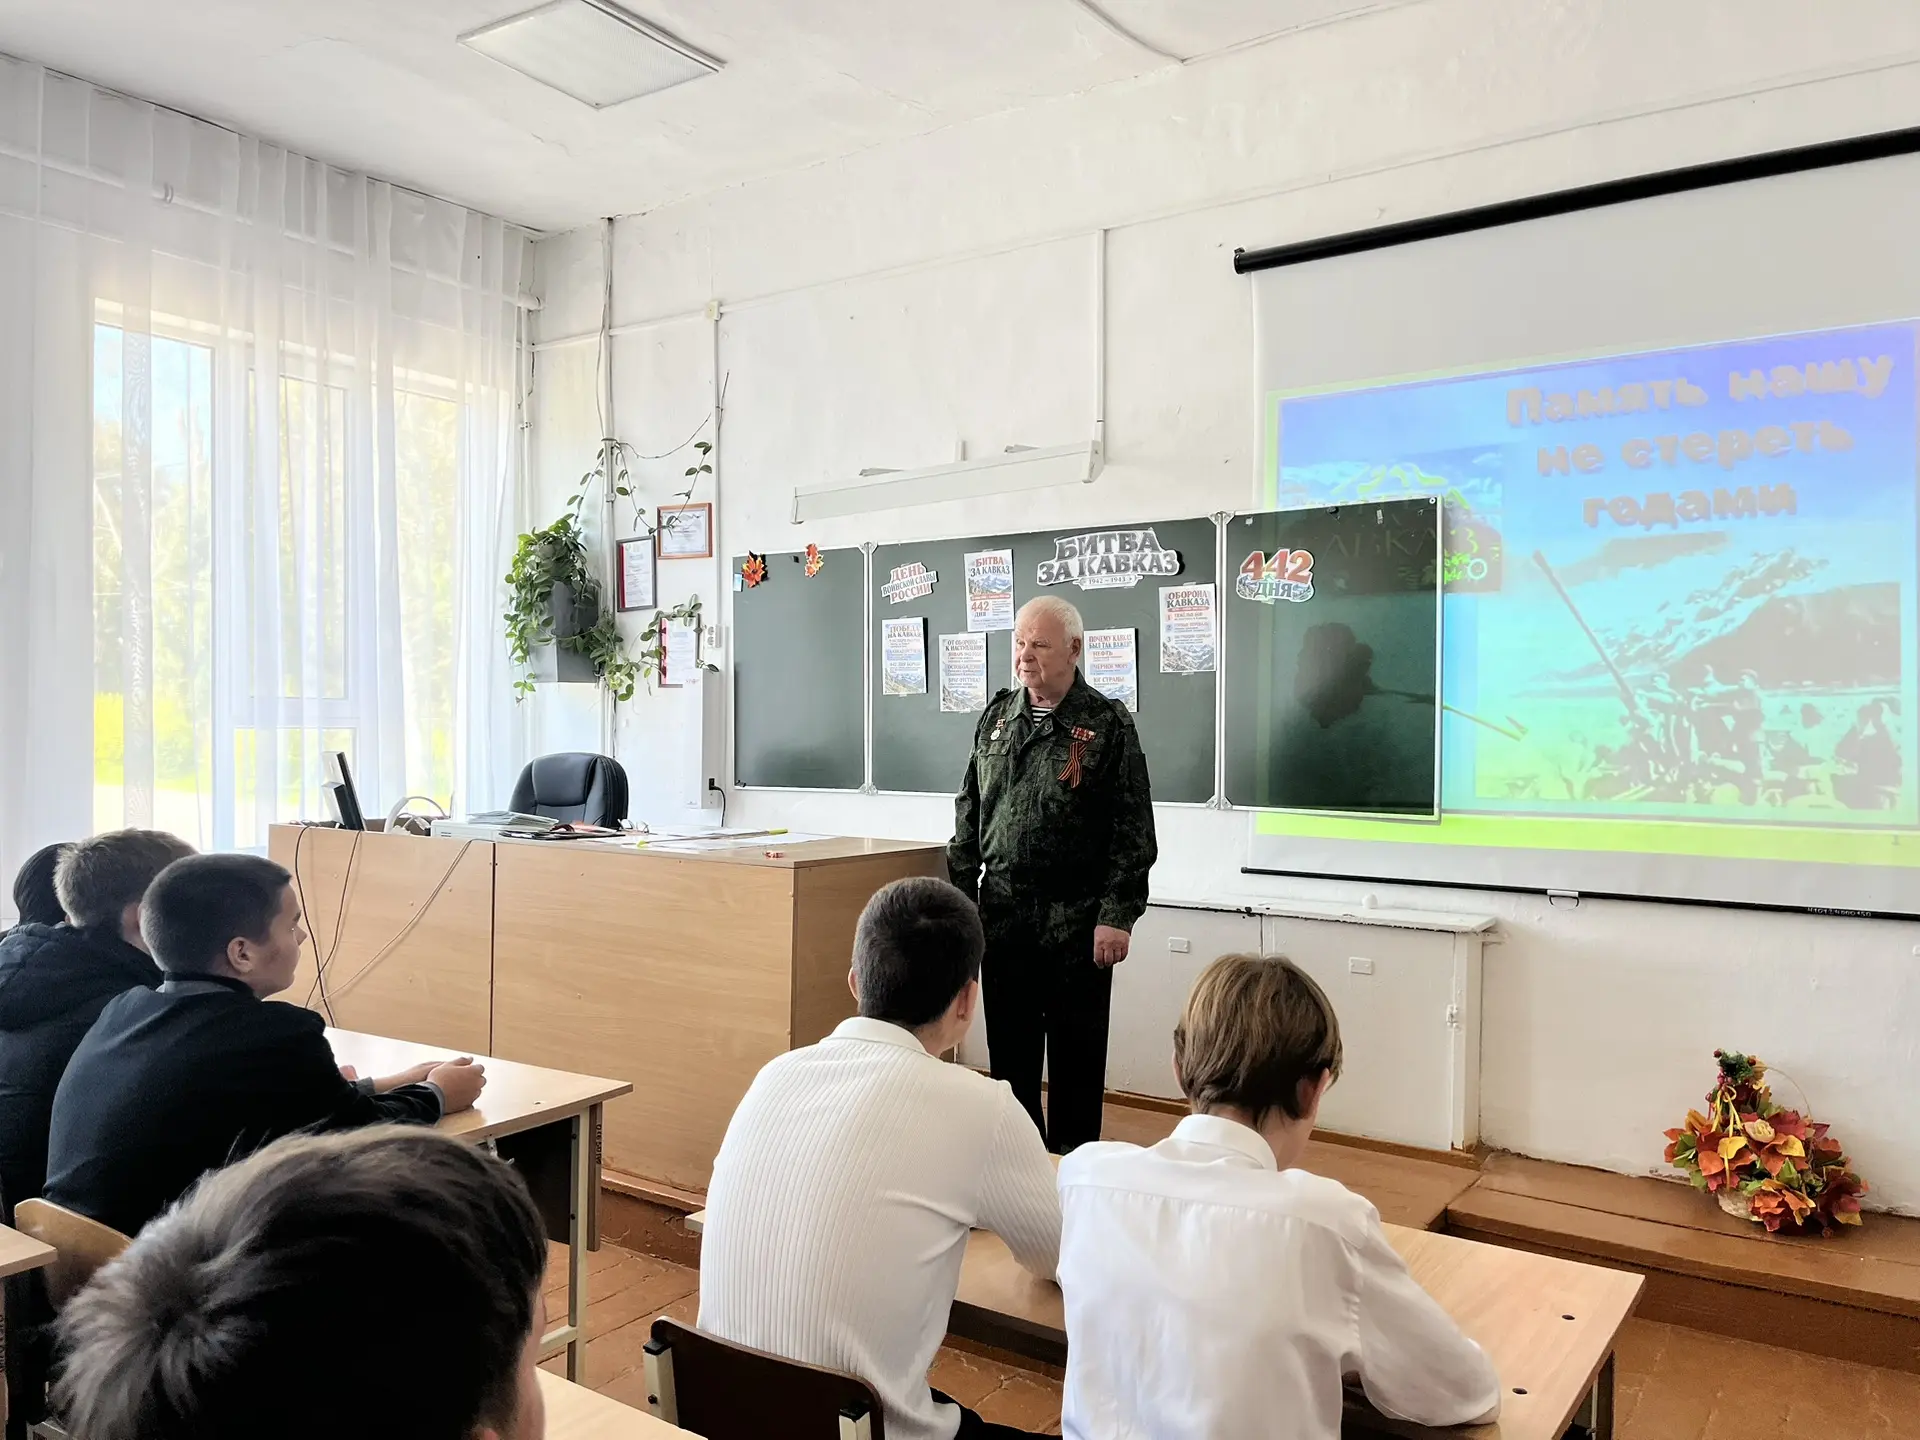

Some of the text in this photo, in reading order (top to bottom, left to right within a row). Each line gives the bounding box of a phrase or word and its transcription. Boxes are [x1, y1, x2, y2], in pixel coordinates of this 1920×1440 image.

[1506, 354, 1894, 427] Память нашу
[1537, 420, 1855, 476] не стереть
[1583, 482, 1798, 531] годами
[1056, 531, 1162, 561] БИТВА
[970, 565, 1010, 577] ЗА КАВКАЗ
[975, 556, 1005, 567] БИТВА
[1038, 551, 1179, 583] ЗА КАВКАЗ
[1241, 550, 1312, 584] 442
[892, 564, 926, 583] ДЕНЬ
[890, 583, 931, 602] РОССИИ
[1168, 590, 1208, 600] ОБОРОНА
[1252, 582, 1293, 599] ДНЯ
[971, 601, 989, 612] 442
[1166, 598, 1210, 608] КАВКАЗА
